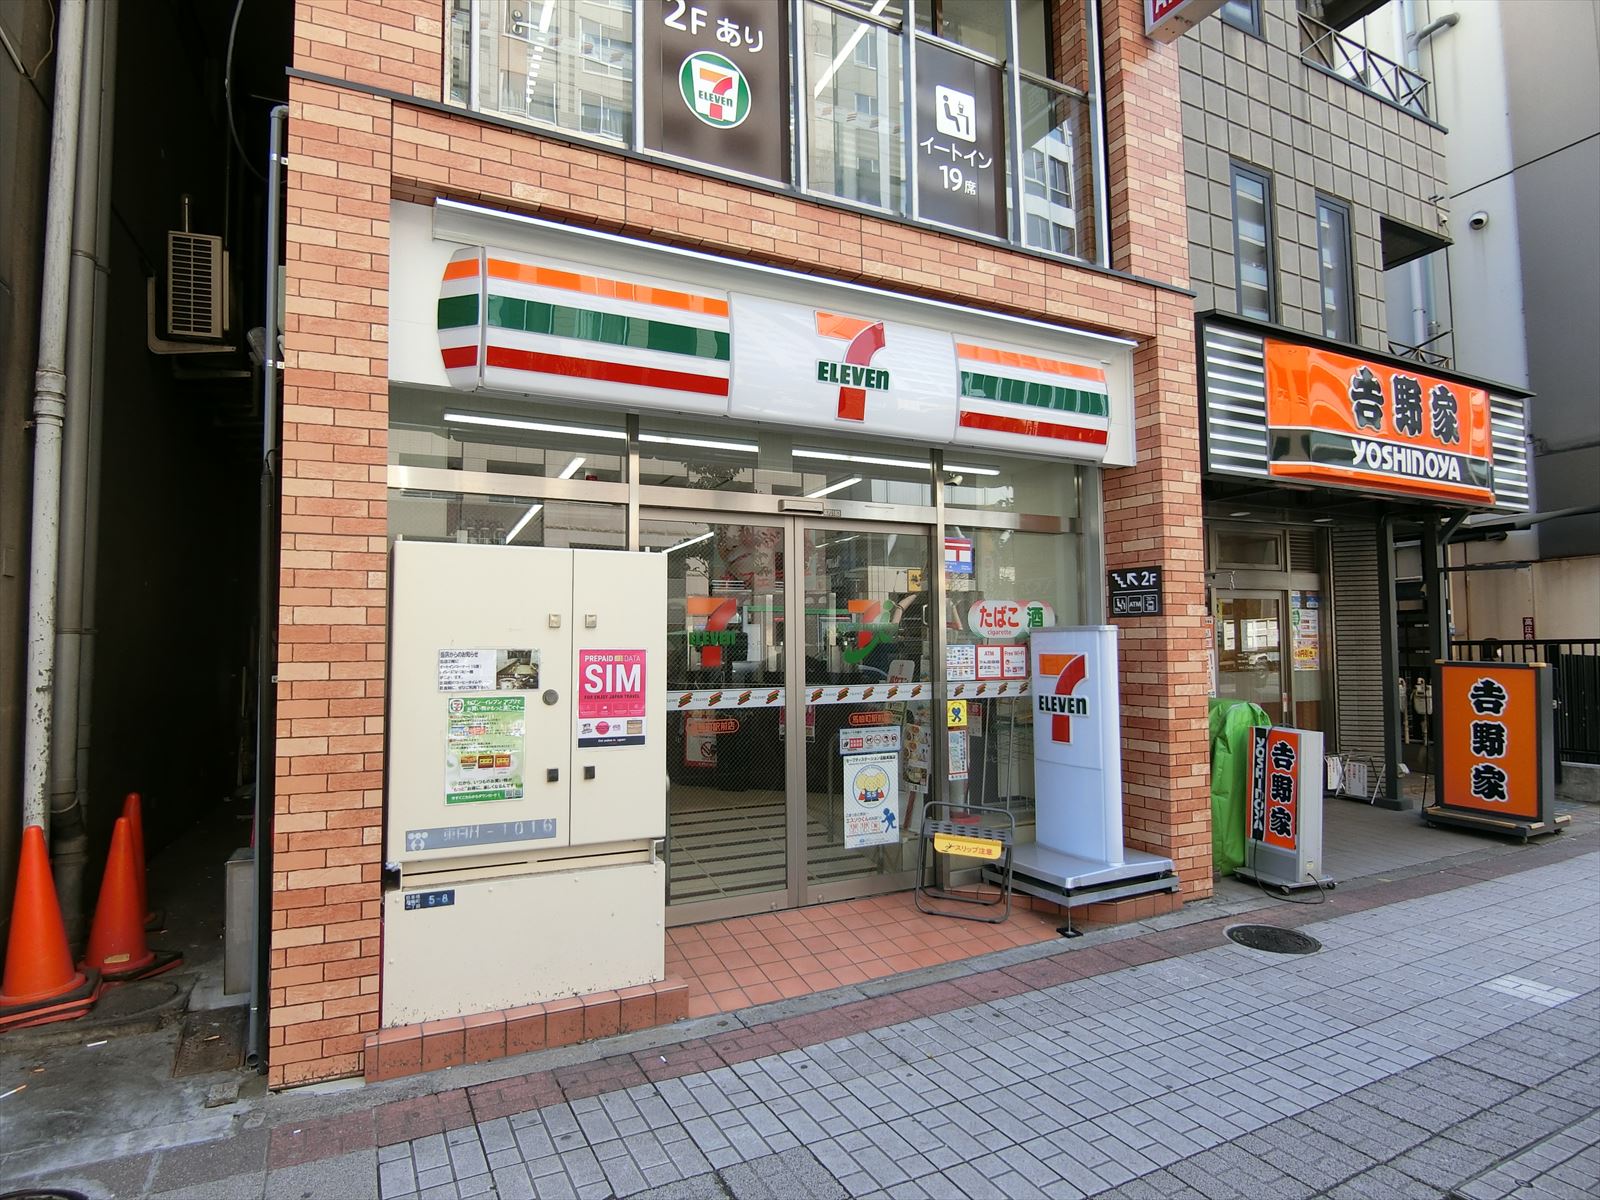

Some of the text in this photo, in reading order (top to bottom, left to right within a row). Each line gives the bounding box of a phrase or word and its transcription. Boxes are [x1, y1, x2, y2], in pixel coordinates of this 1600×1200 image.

[664, 0, 764, 53] 2F あり
[920, 137, 993, 169] イートイン
[939, 165, 977, 196] 19席
[1141, 571, 1157, 586] 2F
[979, 606, 1044, 628] たばこ 酒
[1524, 618, 1536, 649] 高圧危
[584, 663, 641, 694] SIM
[428, 893, 449, 905] 5-8
